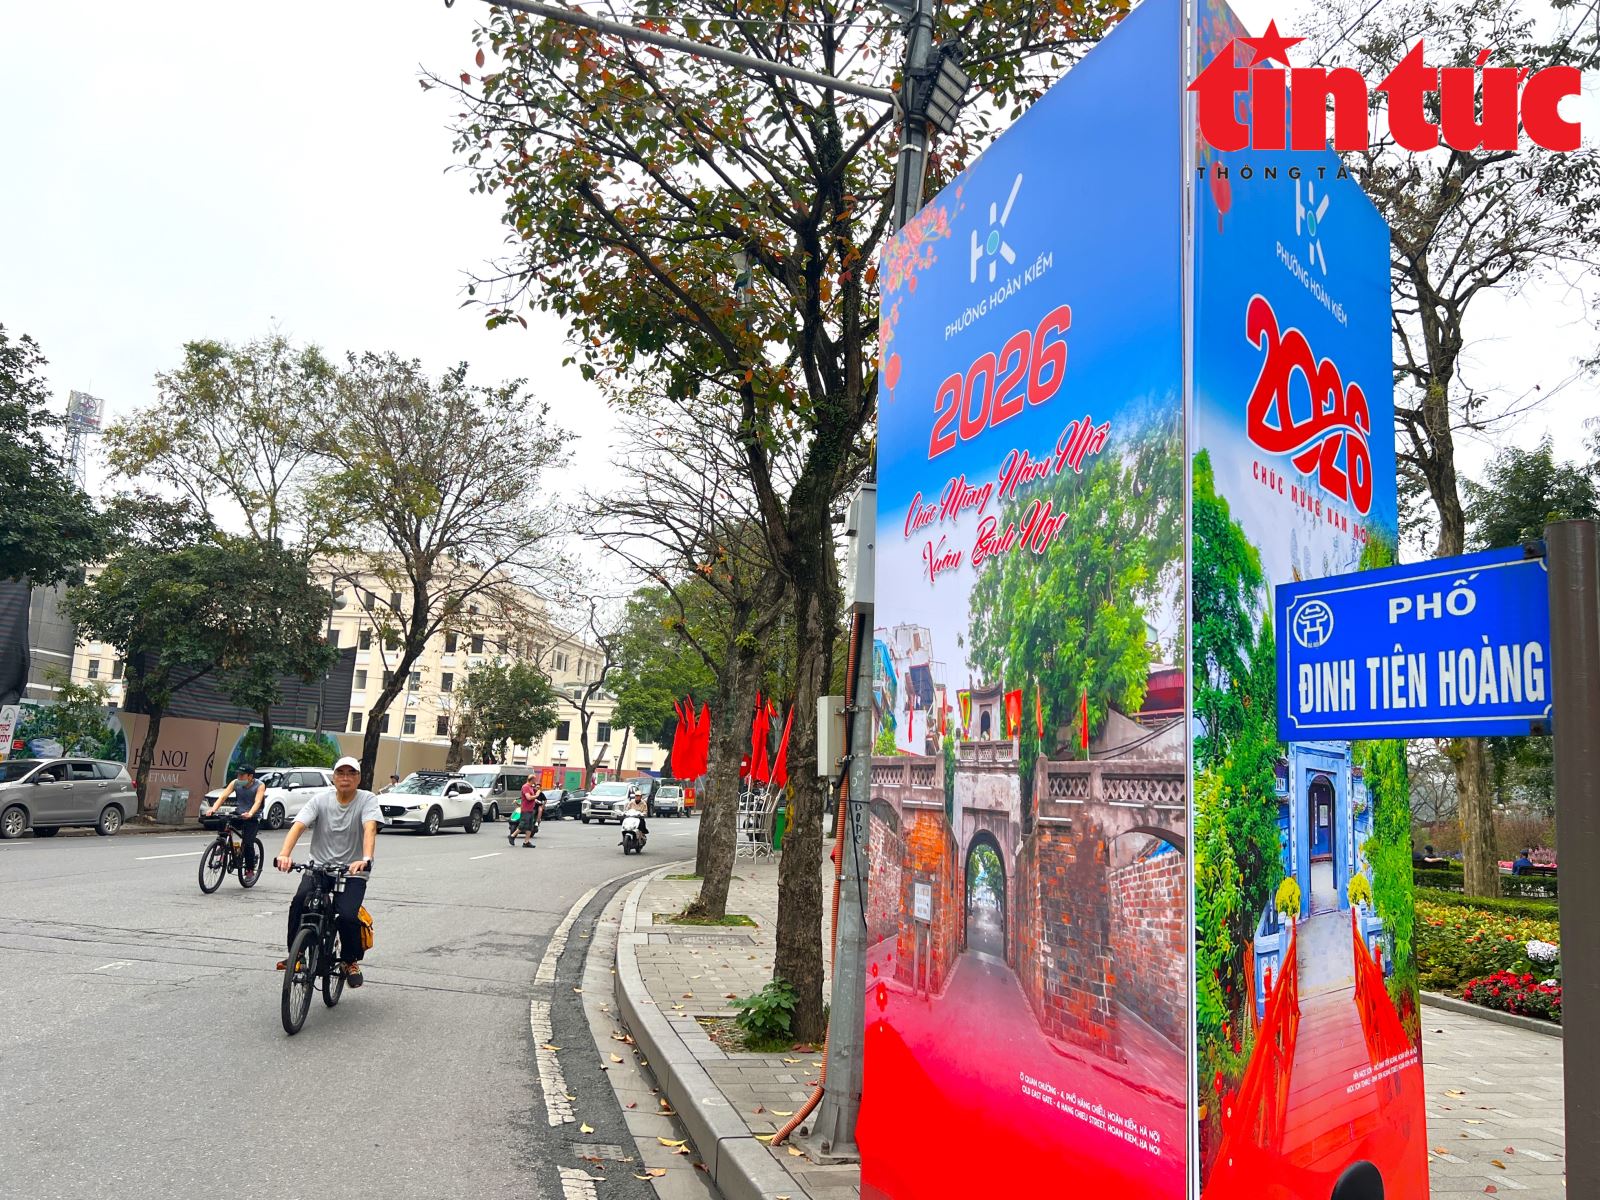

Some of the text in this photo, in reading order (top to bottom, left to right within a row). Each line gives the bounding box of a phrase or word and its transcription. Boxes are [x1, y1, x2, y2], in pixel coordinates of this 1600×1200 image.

[945, 251, 1053, 341] PHƯỜNG HOÀN KIẾM
[1276, 240, 1309, 289] PHƯỜNG
[1310, 277, 1331, 311] HOÀN
[928, 304, 1072, 460] 2026
[1253, 460, 1283, 495] CHÚC
[904, 491, 938, 540] Chúc
[923, 534, 964, 584] Xuân
[1020, 498, 1069, 555] Ngọ
[1388, 572, 1480, 625] PHỐ
[1298, 634, 1545, 714] ĐINH TIÊN HOÀNG
[160, 750, 189, 767] NOI
